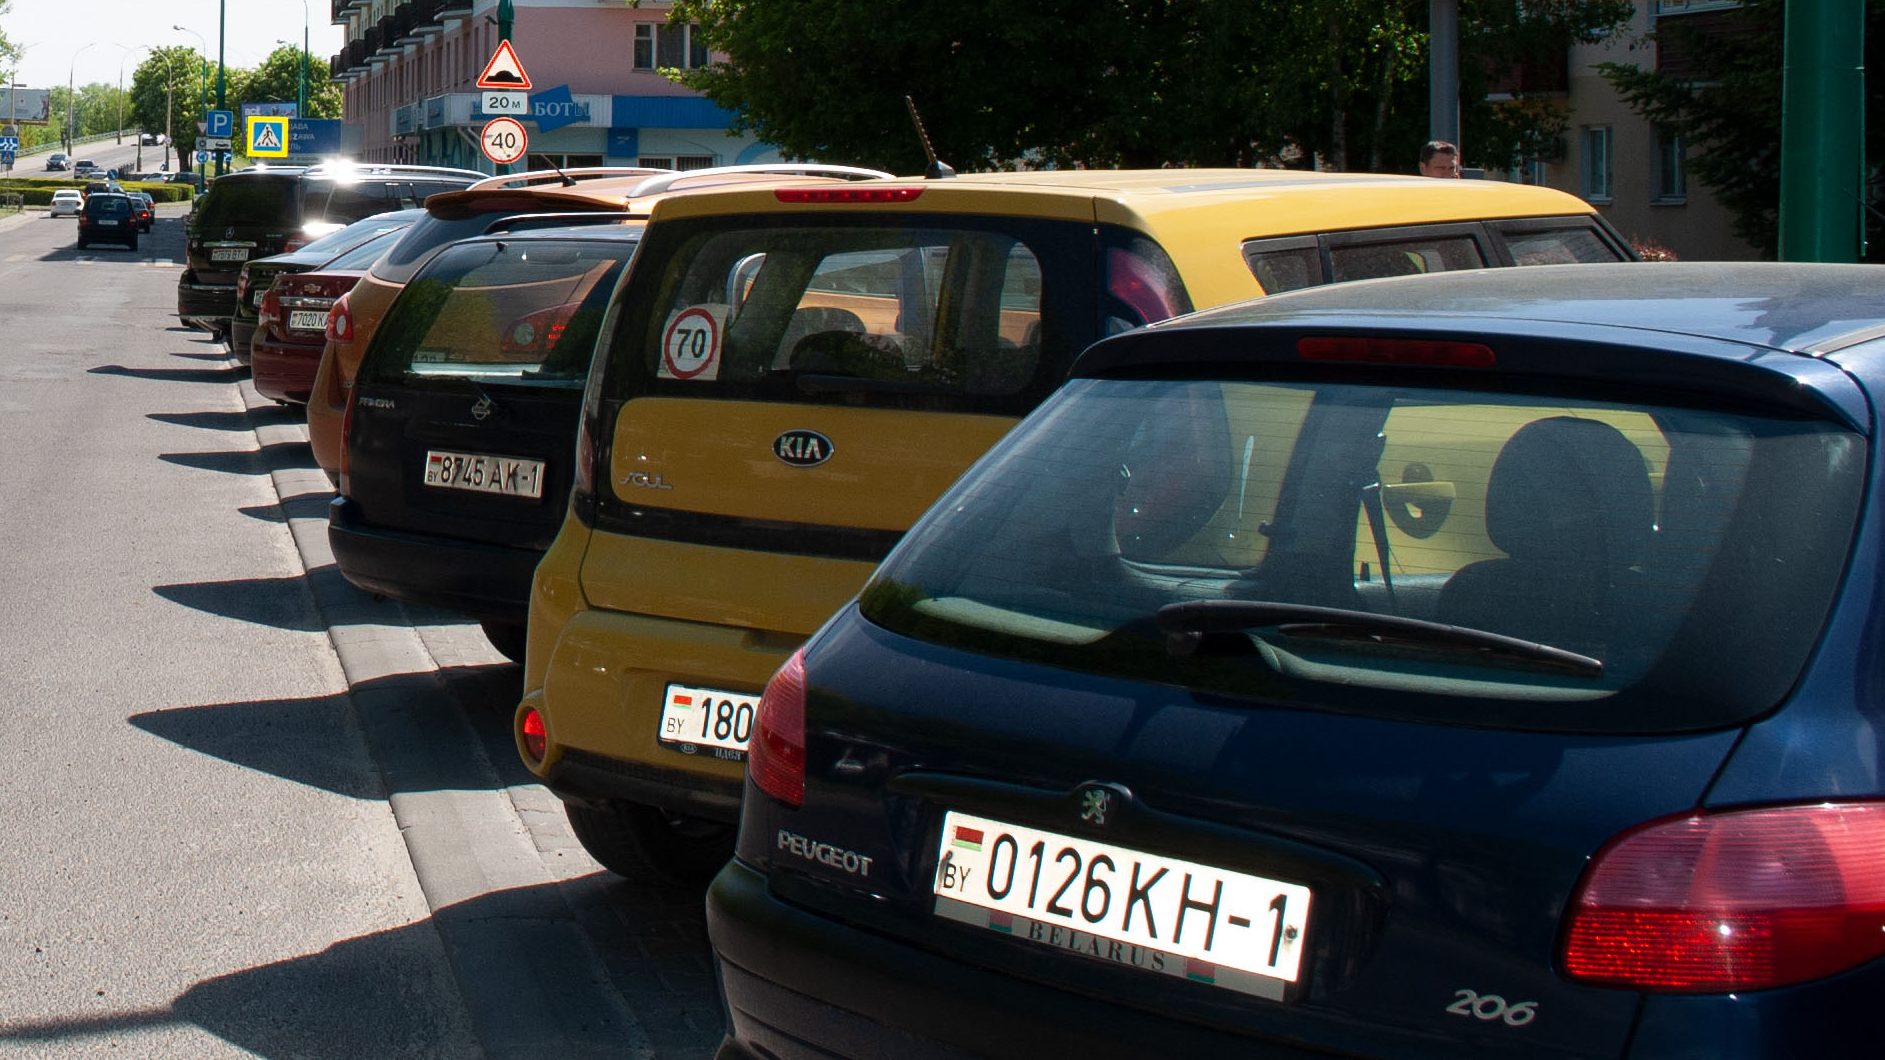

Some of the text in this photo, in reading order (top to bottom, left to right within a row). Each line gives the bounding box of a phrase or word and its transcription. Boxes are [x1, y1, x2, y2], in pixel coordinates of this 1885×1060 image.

[489, 96, 509, 108] 20
[491, 132, 516, 149] 40
[677, 328, 707, 358] 70
[779, 436, 822, 459] KIA
[666, 717, 684, 734] BY
[778, 829, 873, 876] PEUGEOT
[942, 863, 972, 893] BY
[1027, 920, 1166, 973] BELARUS
[1445, 989, 1539, 1026] 206
